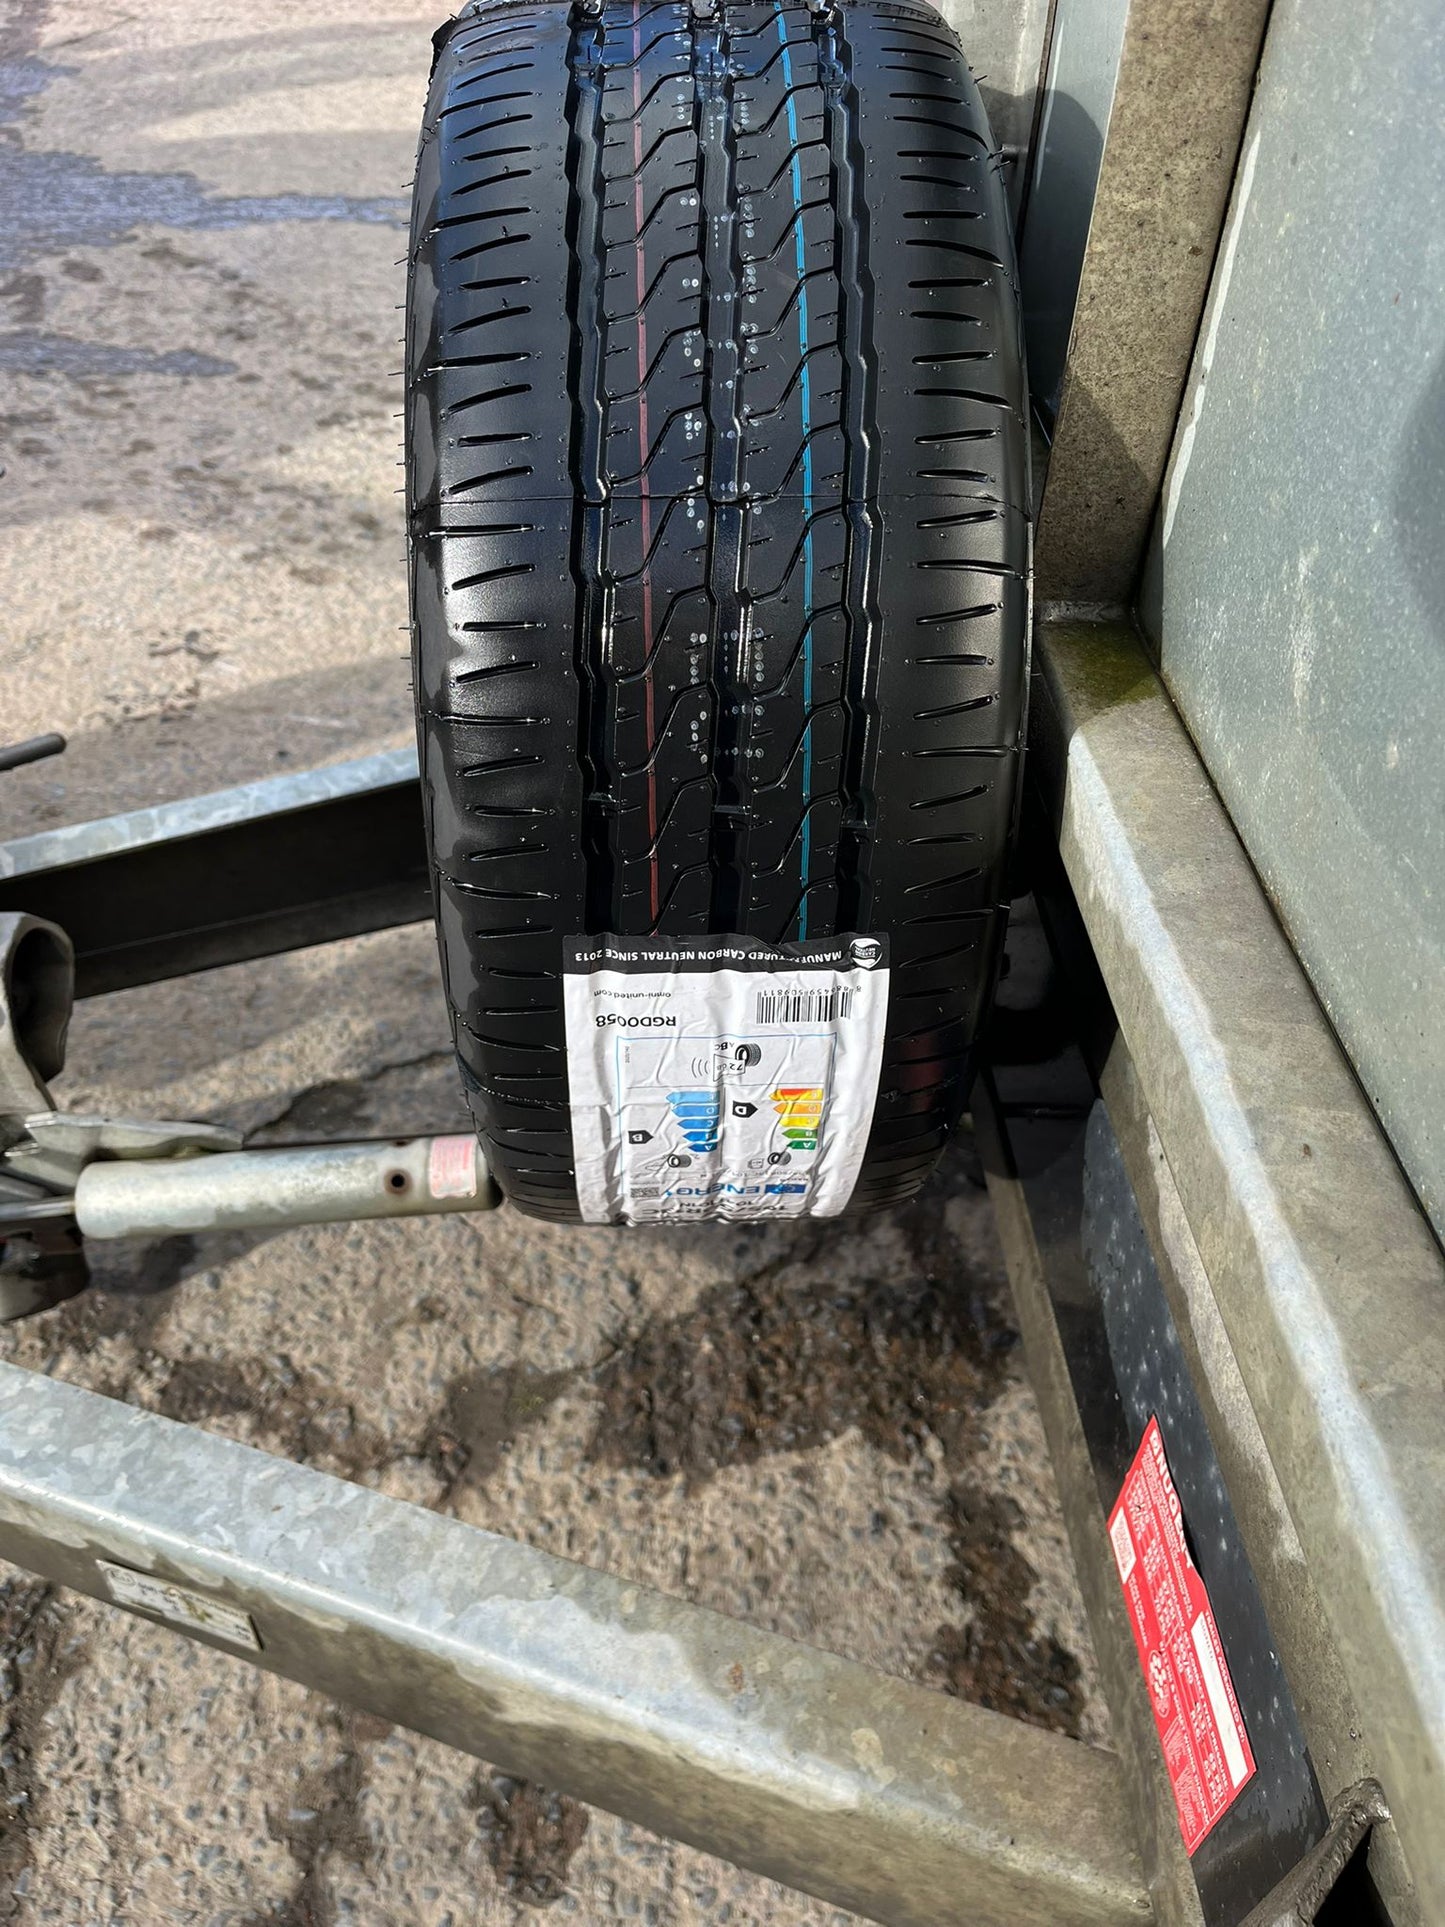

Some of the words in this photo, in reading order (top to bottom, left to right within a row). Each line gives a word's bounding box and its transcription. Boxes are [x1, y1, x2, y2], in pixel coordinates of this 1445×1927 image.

[575, 950, 602, 961] 2013
[605, 949, 638, 961] SINCE
[641, 951, 694, 960] NEUTRAL
[698, 949, 745, 960] CARBON
[594, 990, 671, 998] omni-united.com
[729, 1063, 743, 1071] 72
[735, 1106, 747, 1115] D
[632, 1134, 643, 1142] B
[665, 1183, 760, 1197] ENERG
